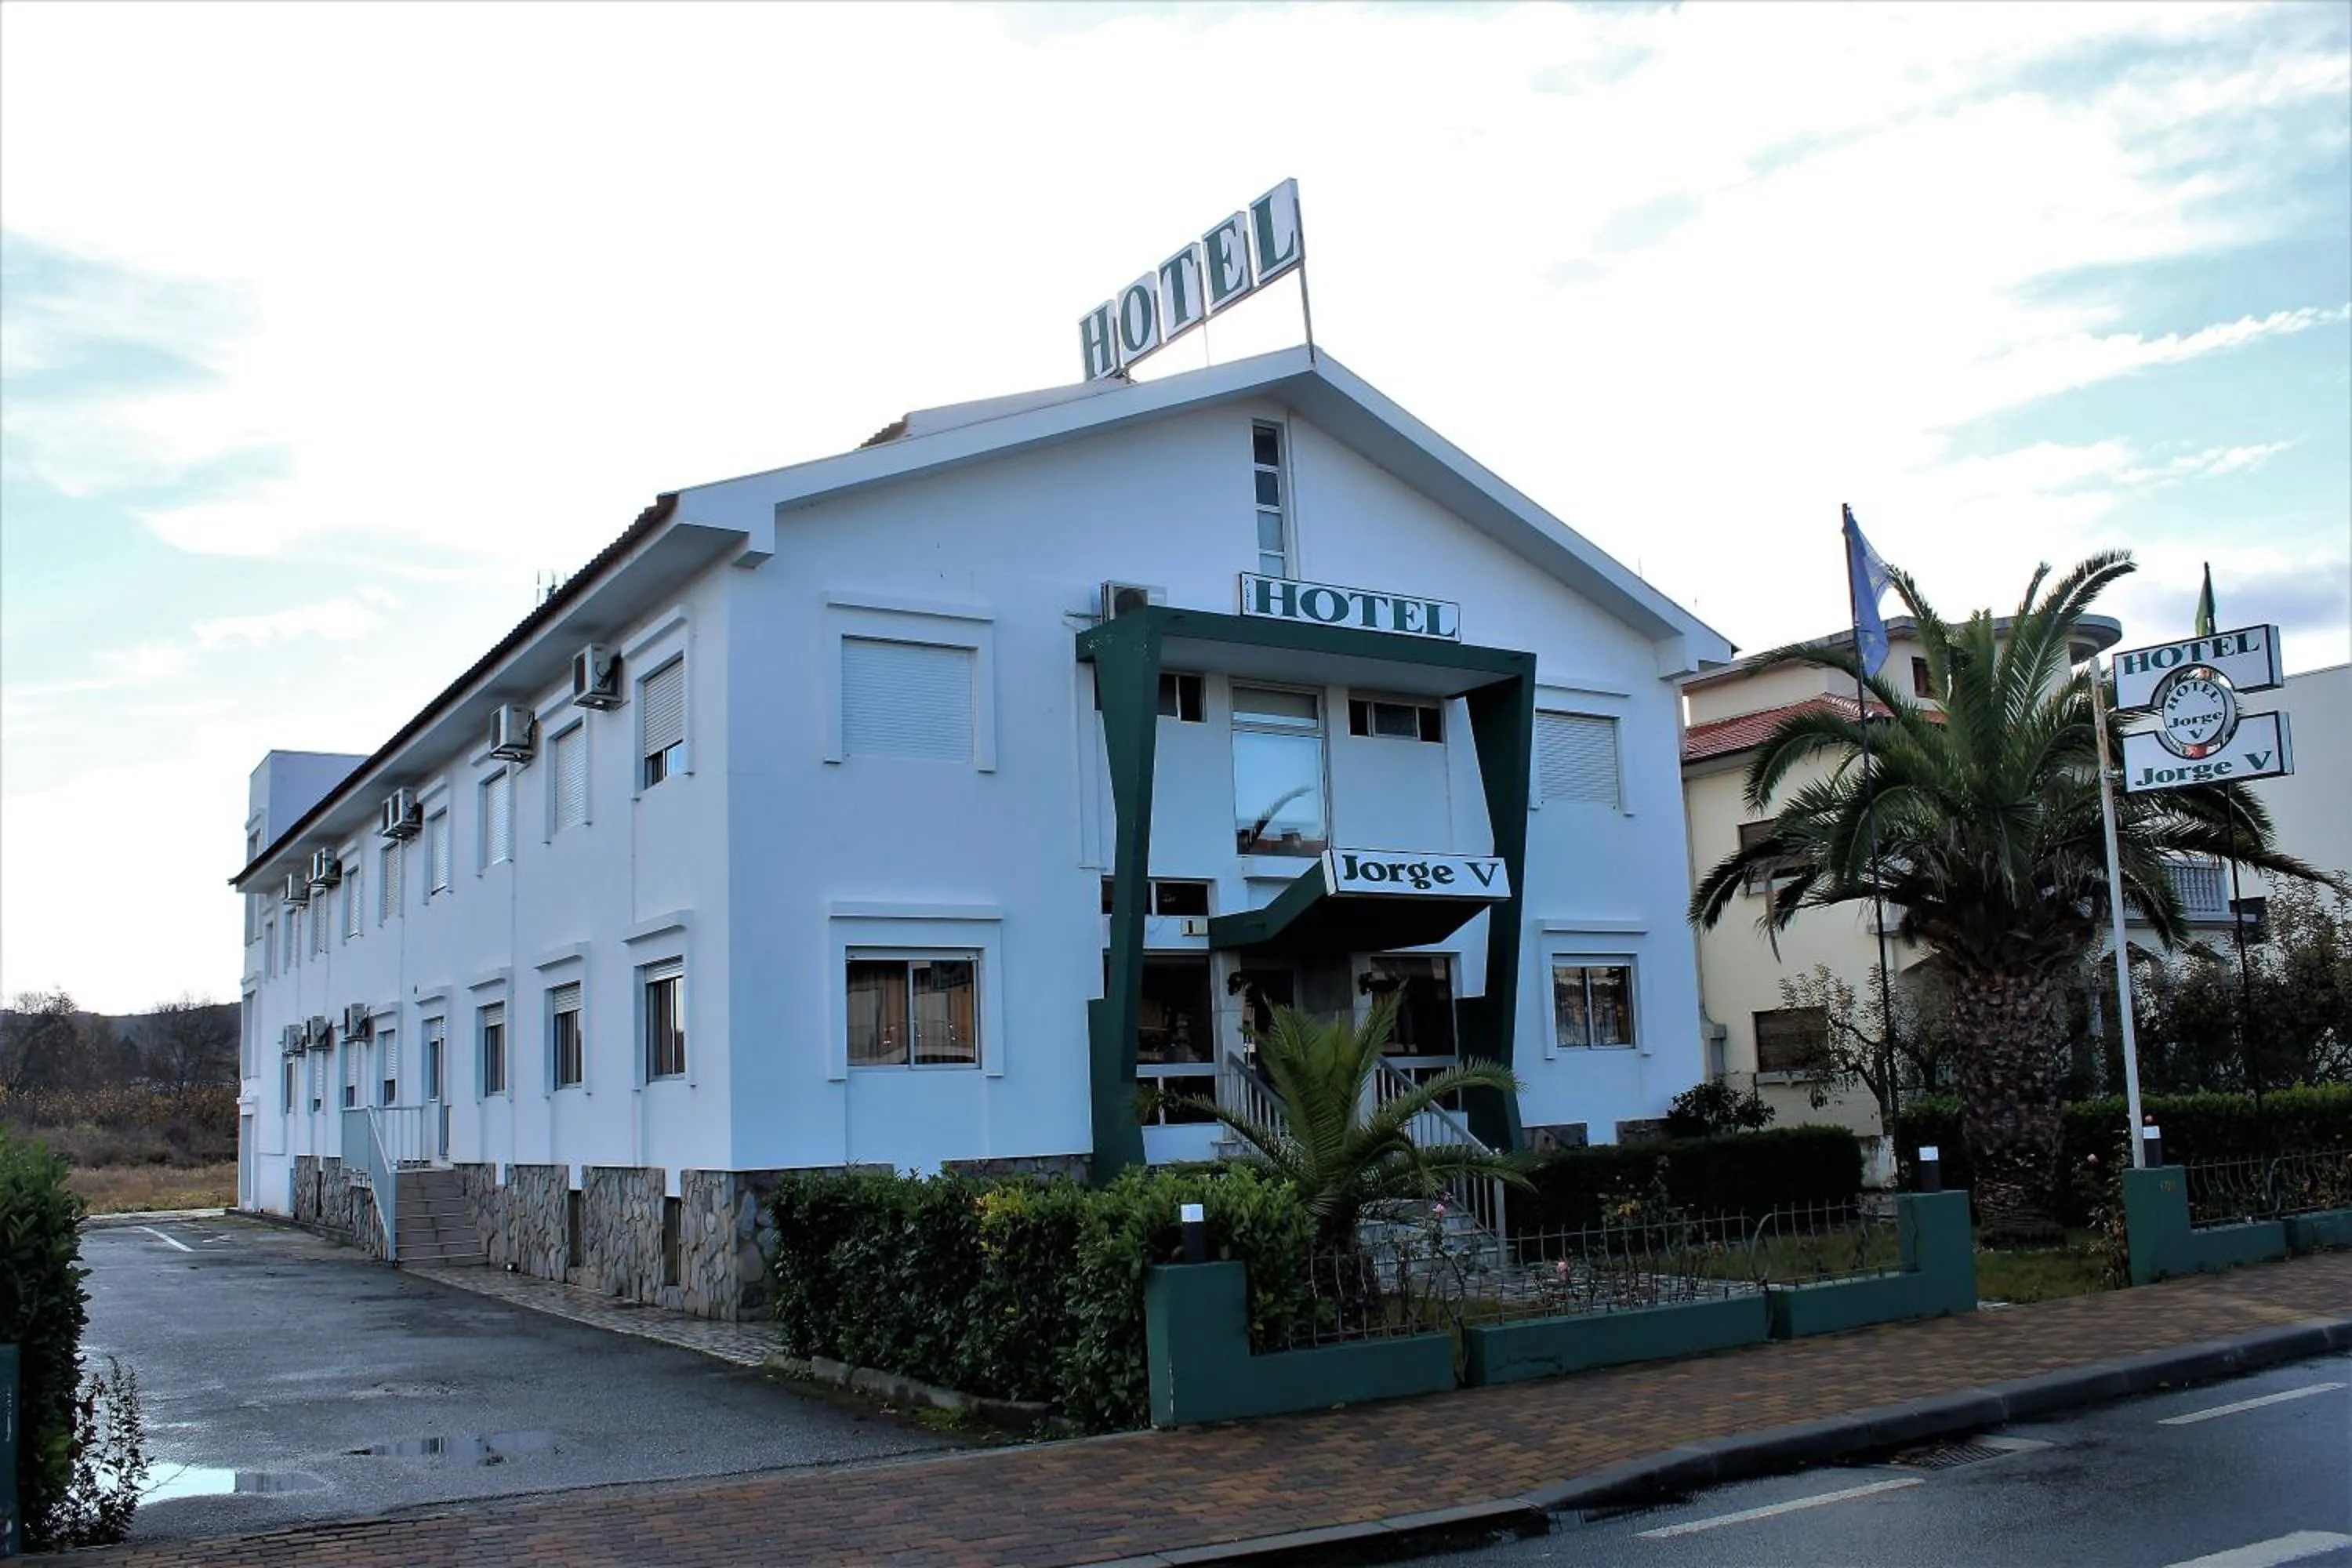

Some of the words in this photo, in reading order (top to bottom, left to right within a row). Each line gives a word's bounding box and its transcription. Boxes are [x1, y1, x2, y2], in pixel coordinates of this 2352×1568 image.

[1079, 194, 1295, 381] HOTEL
[1254, 579, 1456, 637] HOTEL
[2122, 633, 2259, 674] HOTEL
[2166, 681, 2220, 710] HOTEL
[2169, 710, 2223, 729] Jorge
[2189, 728, 2203, 739] V
[2135, 761, 2233, 786] Jorge
[2243, 750, 2273, 771] V
[1341, 854, 1456, 890] Jorge
[1465, 862, 1499, 887] V
